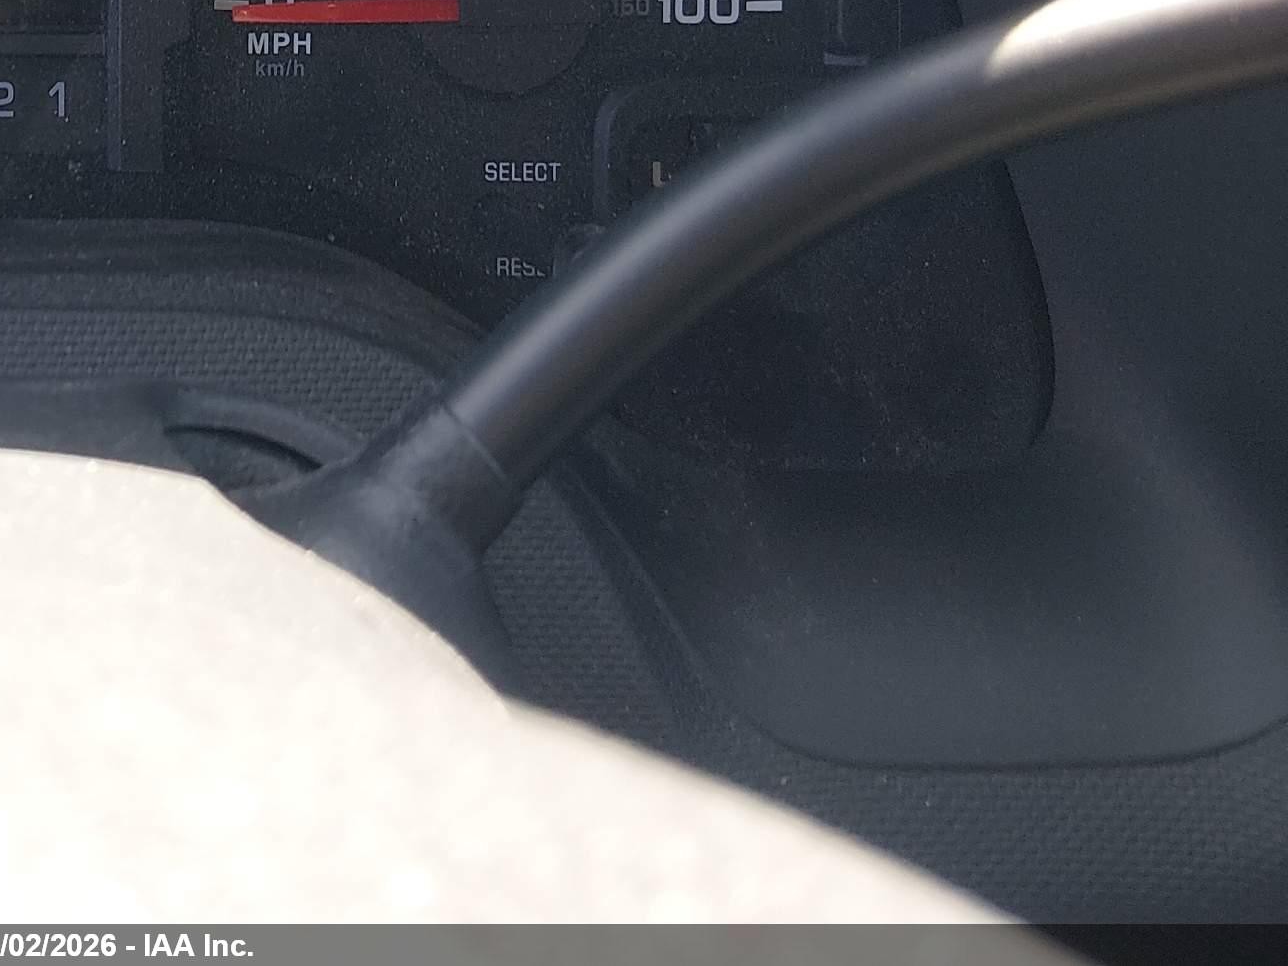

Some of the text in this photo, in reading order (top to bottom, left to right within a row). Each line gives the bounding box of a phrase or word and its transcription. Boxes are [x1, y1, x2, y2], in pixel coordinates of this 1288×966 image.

[247, 32, 311, 54] MPH
[255, 59, 305, 76] km/h
[48, 81, 65, 118] 1
[484, 162, 561, 182] SELECT
